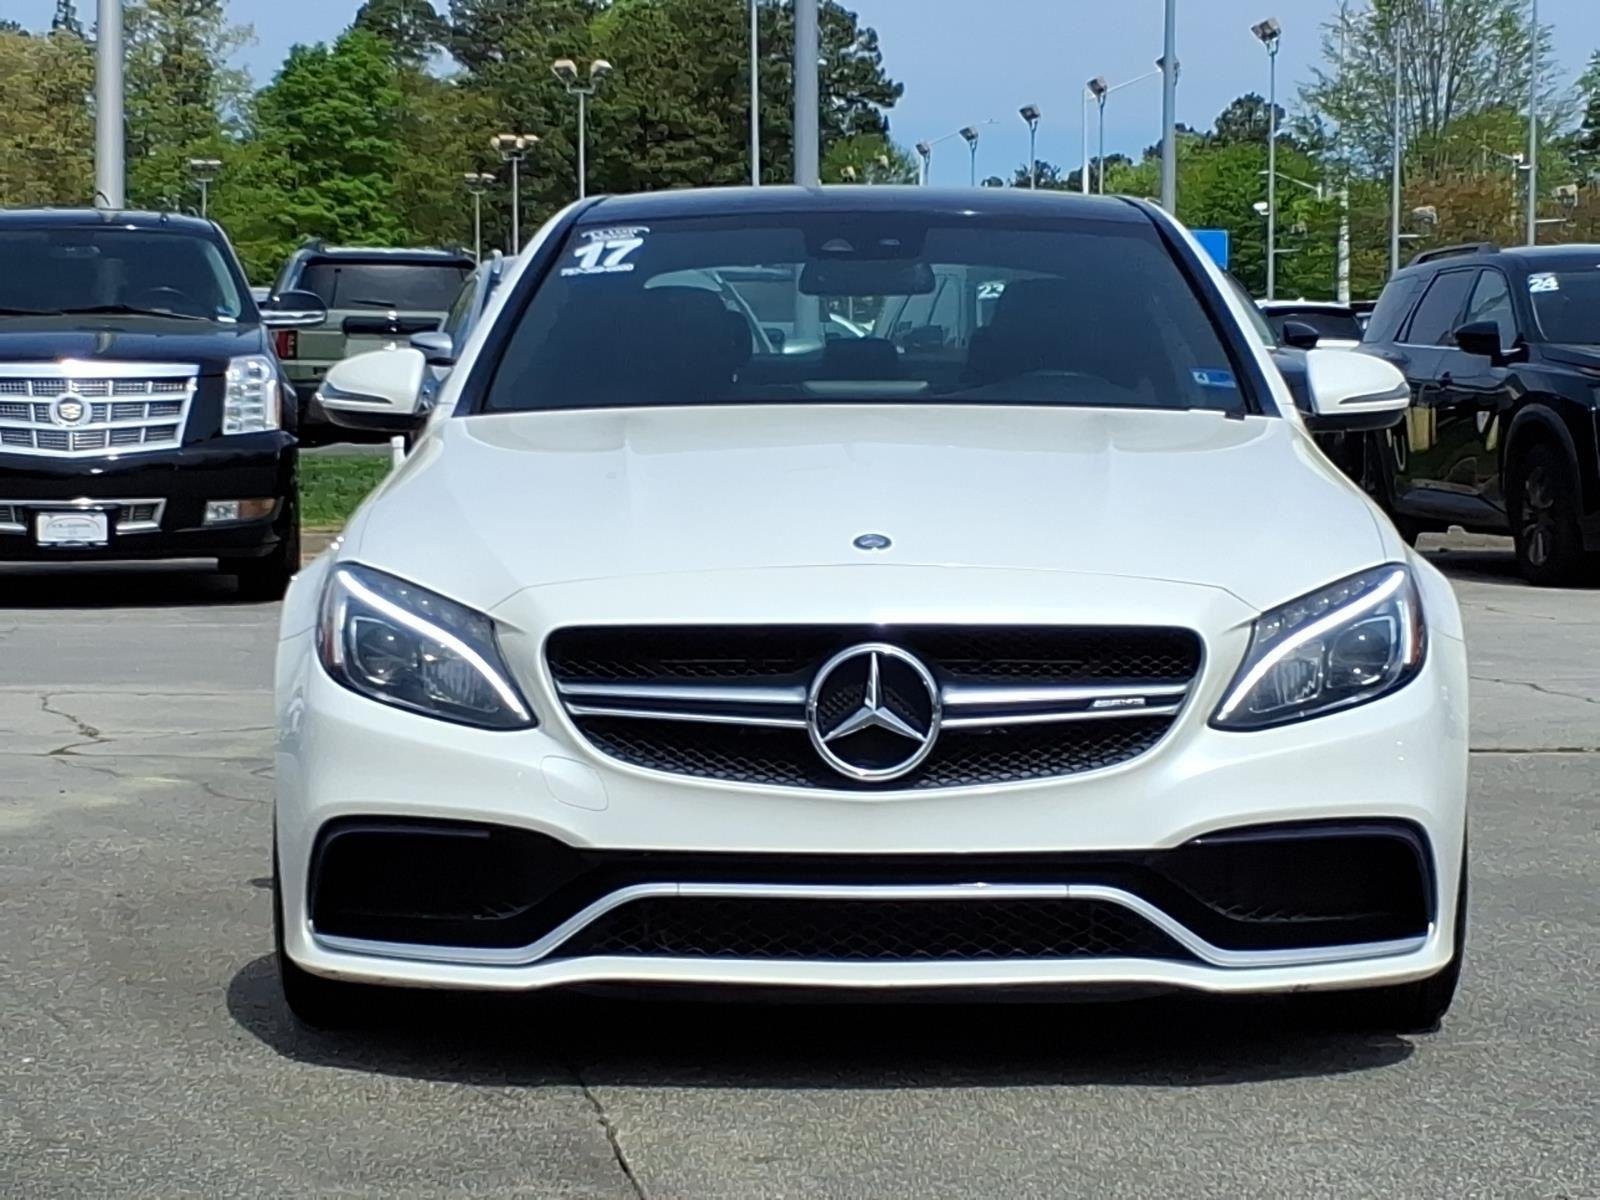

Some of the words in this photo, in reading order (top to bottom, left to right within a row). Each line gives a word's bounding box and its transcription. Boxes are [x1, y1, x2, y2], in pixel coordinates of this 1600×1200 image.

[574, 238, 644, 268] 17
[978, 281, 1005, 299] 23
[1528, 276, 1559, 293] 24
